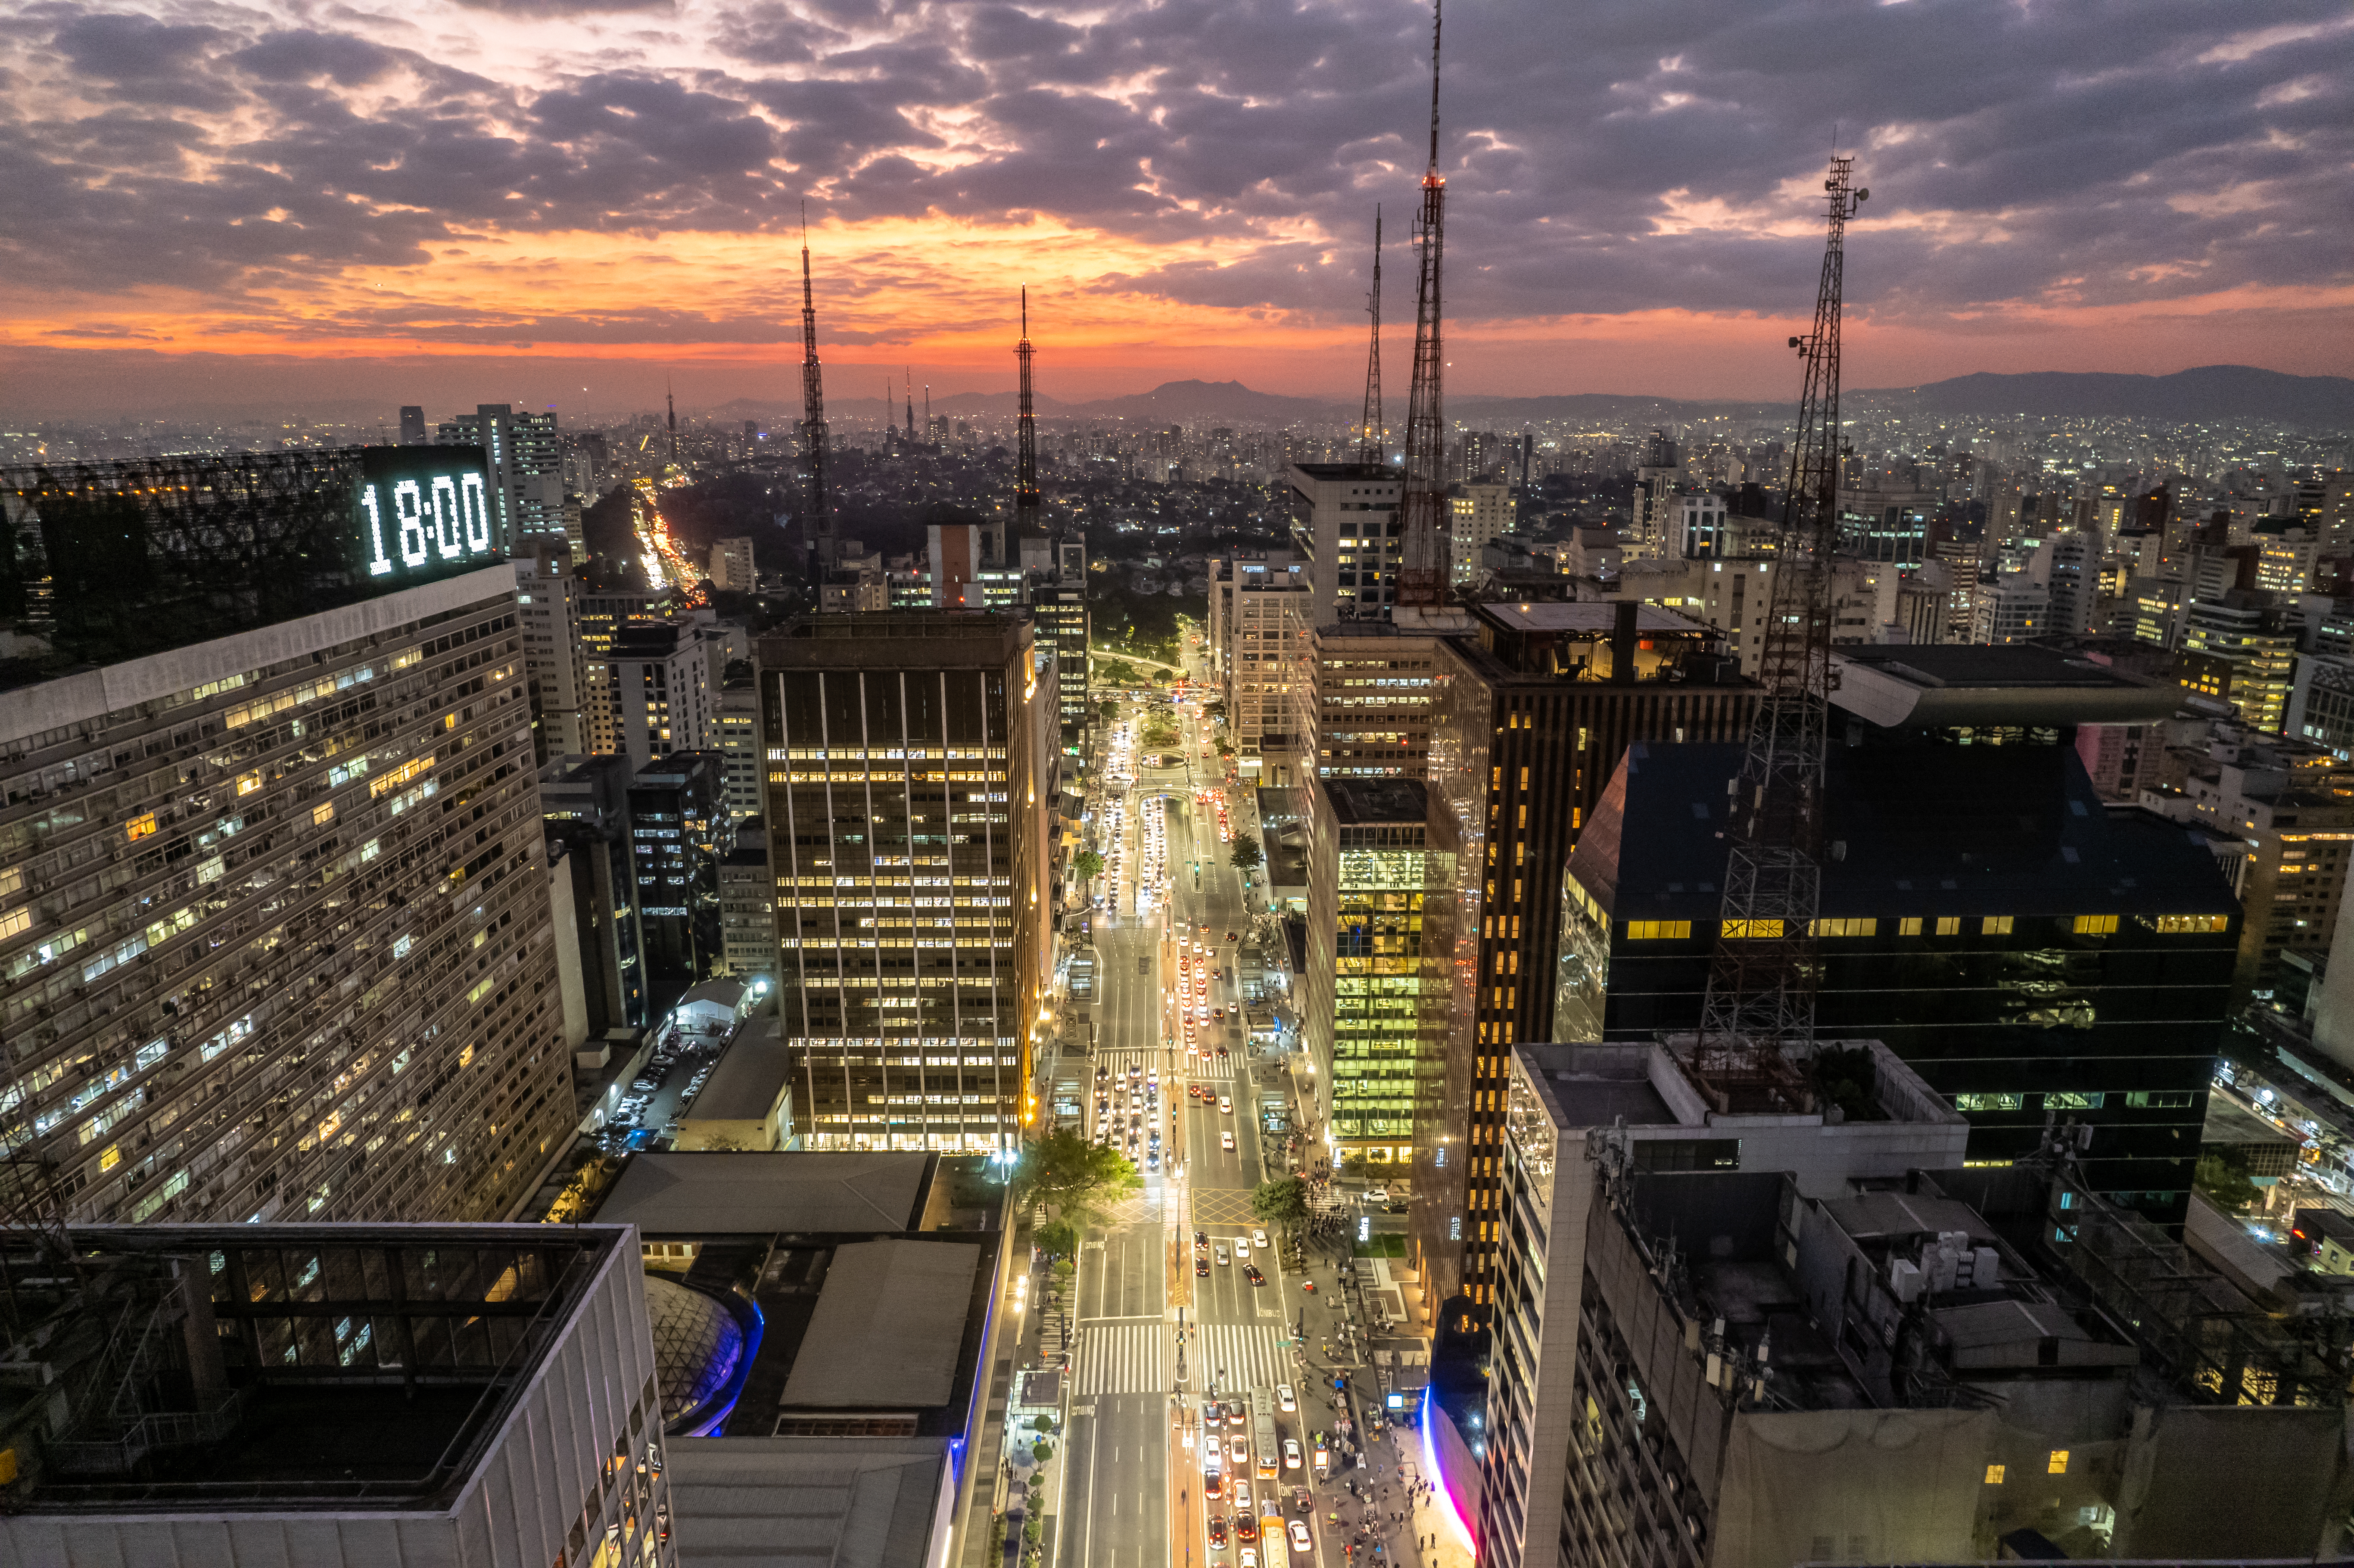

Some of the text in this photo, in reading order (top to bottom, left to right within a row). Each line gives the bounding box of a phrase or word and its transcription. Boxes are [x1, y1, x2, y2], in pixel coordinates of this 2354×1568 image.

[361, 473, 489, 576] 18:00
[1358, 1217, 1369, 1241] Safra
[1085, 1241, 1105, 1251] ÔNIBUS
[1260, 1307, 1280, 1318] ÔNIBUS
[1071, 1405, 1095, 1417] ÔNIBUS
